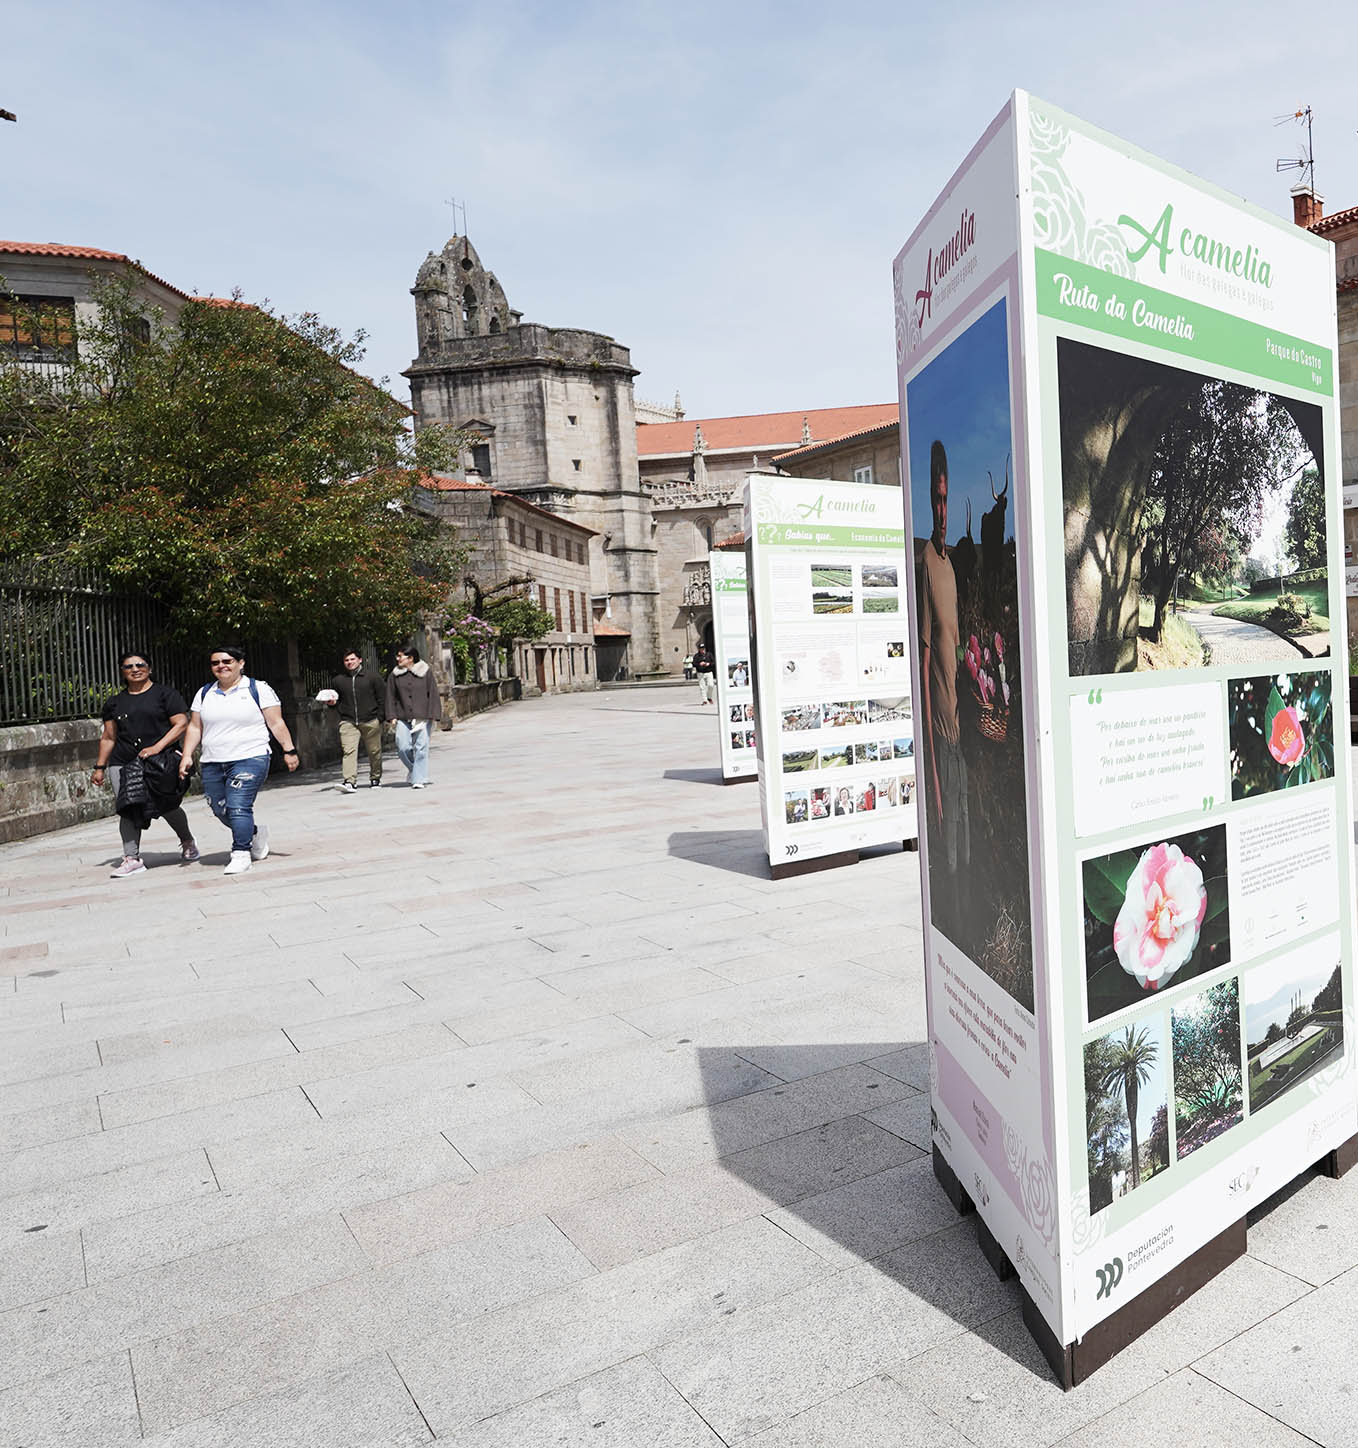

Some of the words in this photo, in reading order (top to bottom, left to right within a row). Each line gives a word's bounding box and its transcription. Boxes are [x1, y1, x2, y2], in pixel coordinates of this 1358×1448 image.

[915, 247, 933, 328] A
[934, 208, 976, 285] camelia
[1117, 203, 1174, 274] A
[1180, 227, 1274, 289] camelia
[1053, 272, 1101, 311] Ruta
[1104, 294, 1128, 321] da
[1132, 299, 1195, 342] Camelia
[1266, 338, 1290, 360] Parque
[1300, 349, 1321, 369] Castro
[797, 495, 824, 519] A
[827, 499, 877, 514] camelia
[1127, 1235, 1174, 1273] Pontevedra
